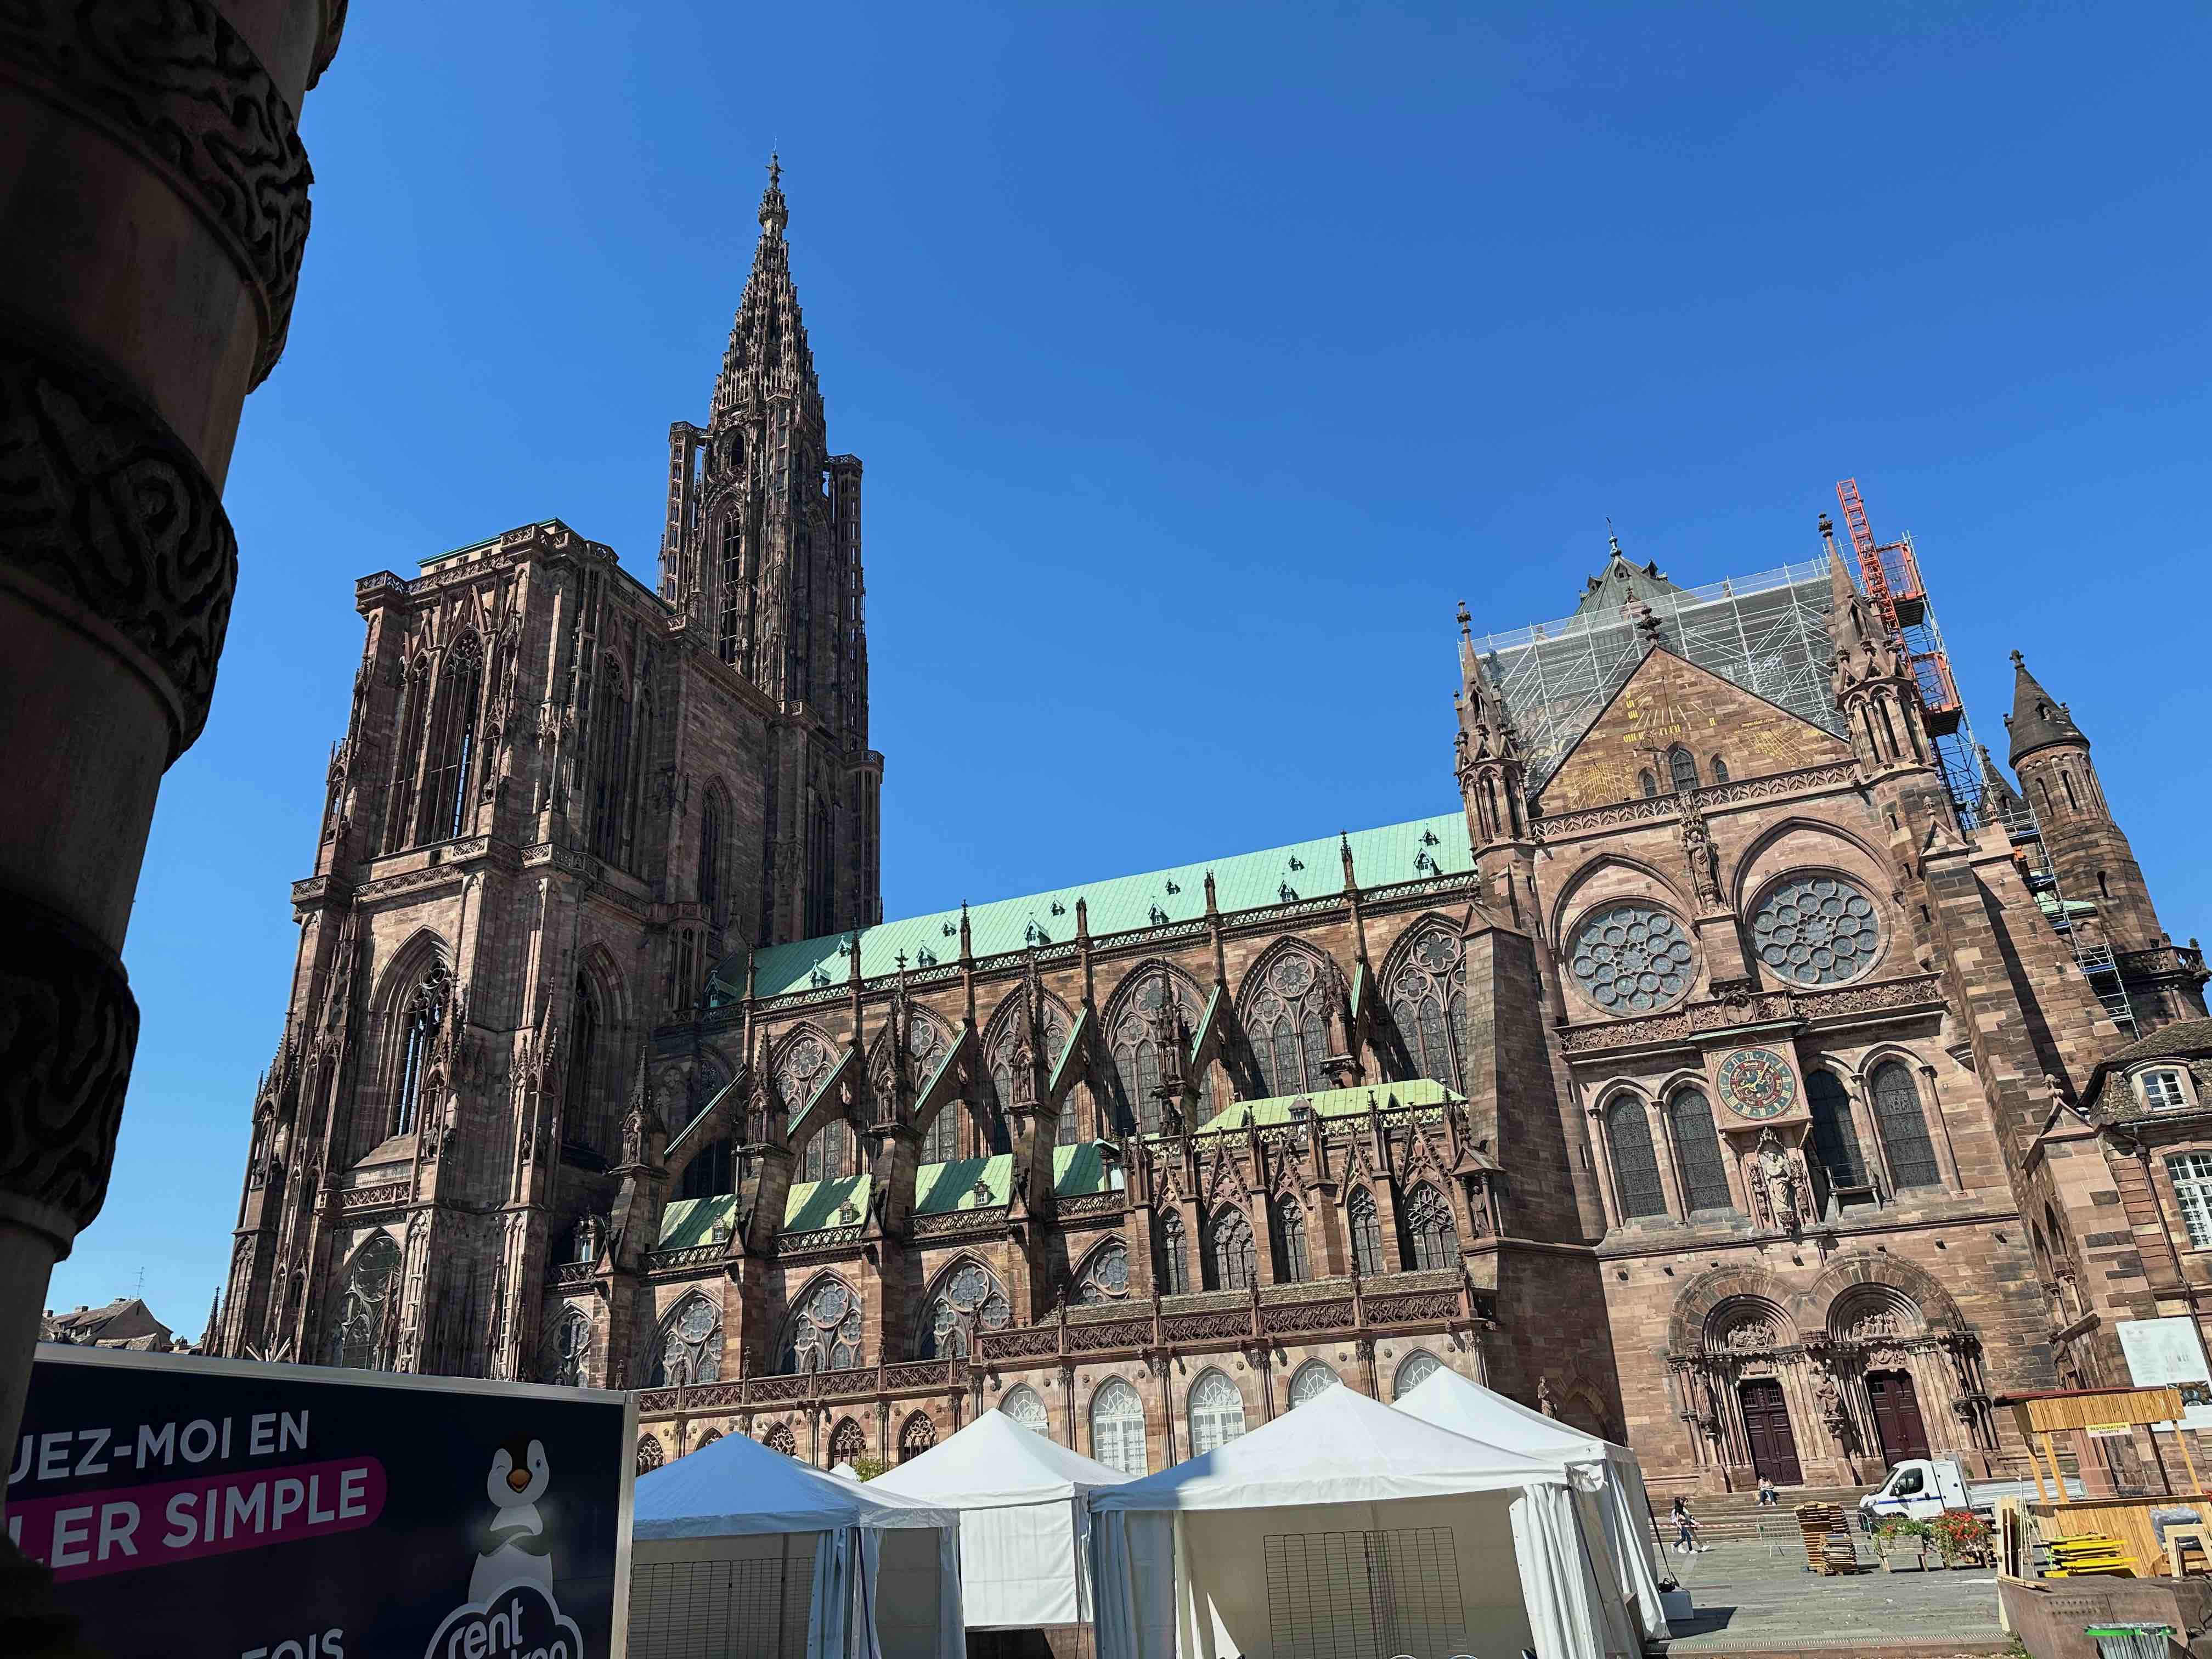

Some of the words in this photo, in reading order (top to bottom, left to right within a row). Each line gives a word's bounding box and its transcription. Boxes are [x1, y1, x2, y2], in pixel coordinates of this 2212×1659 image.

[250, 1410, 308, 1455] EN
[162, 1468, 368, 1548] SIMPLE
[448, 1598, 523, 1659] rent
